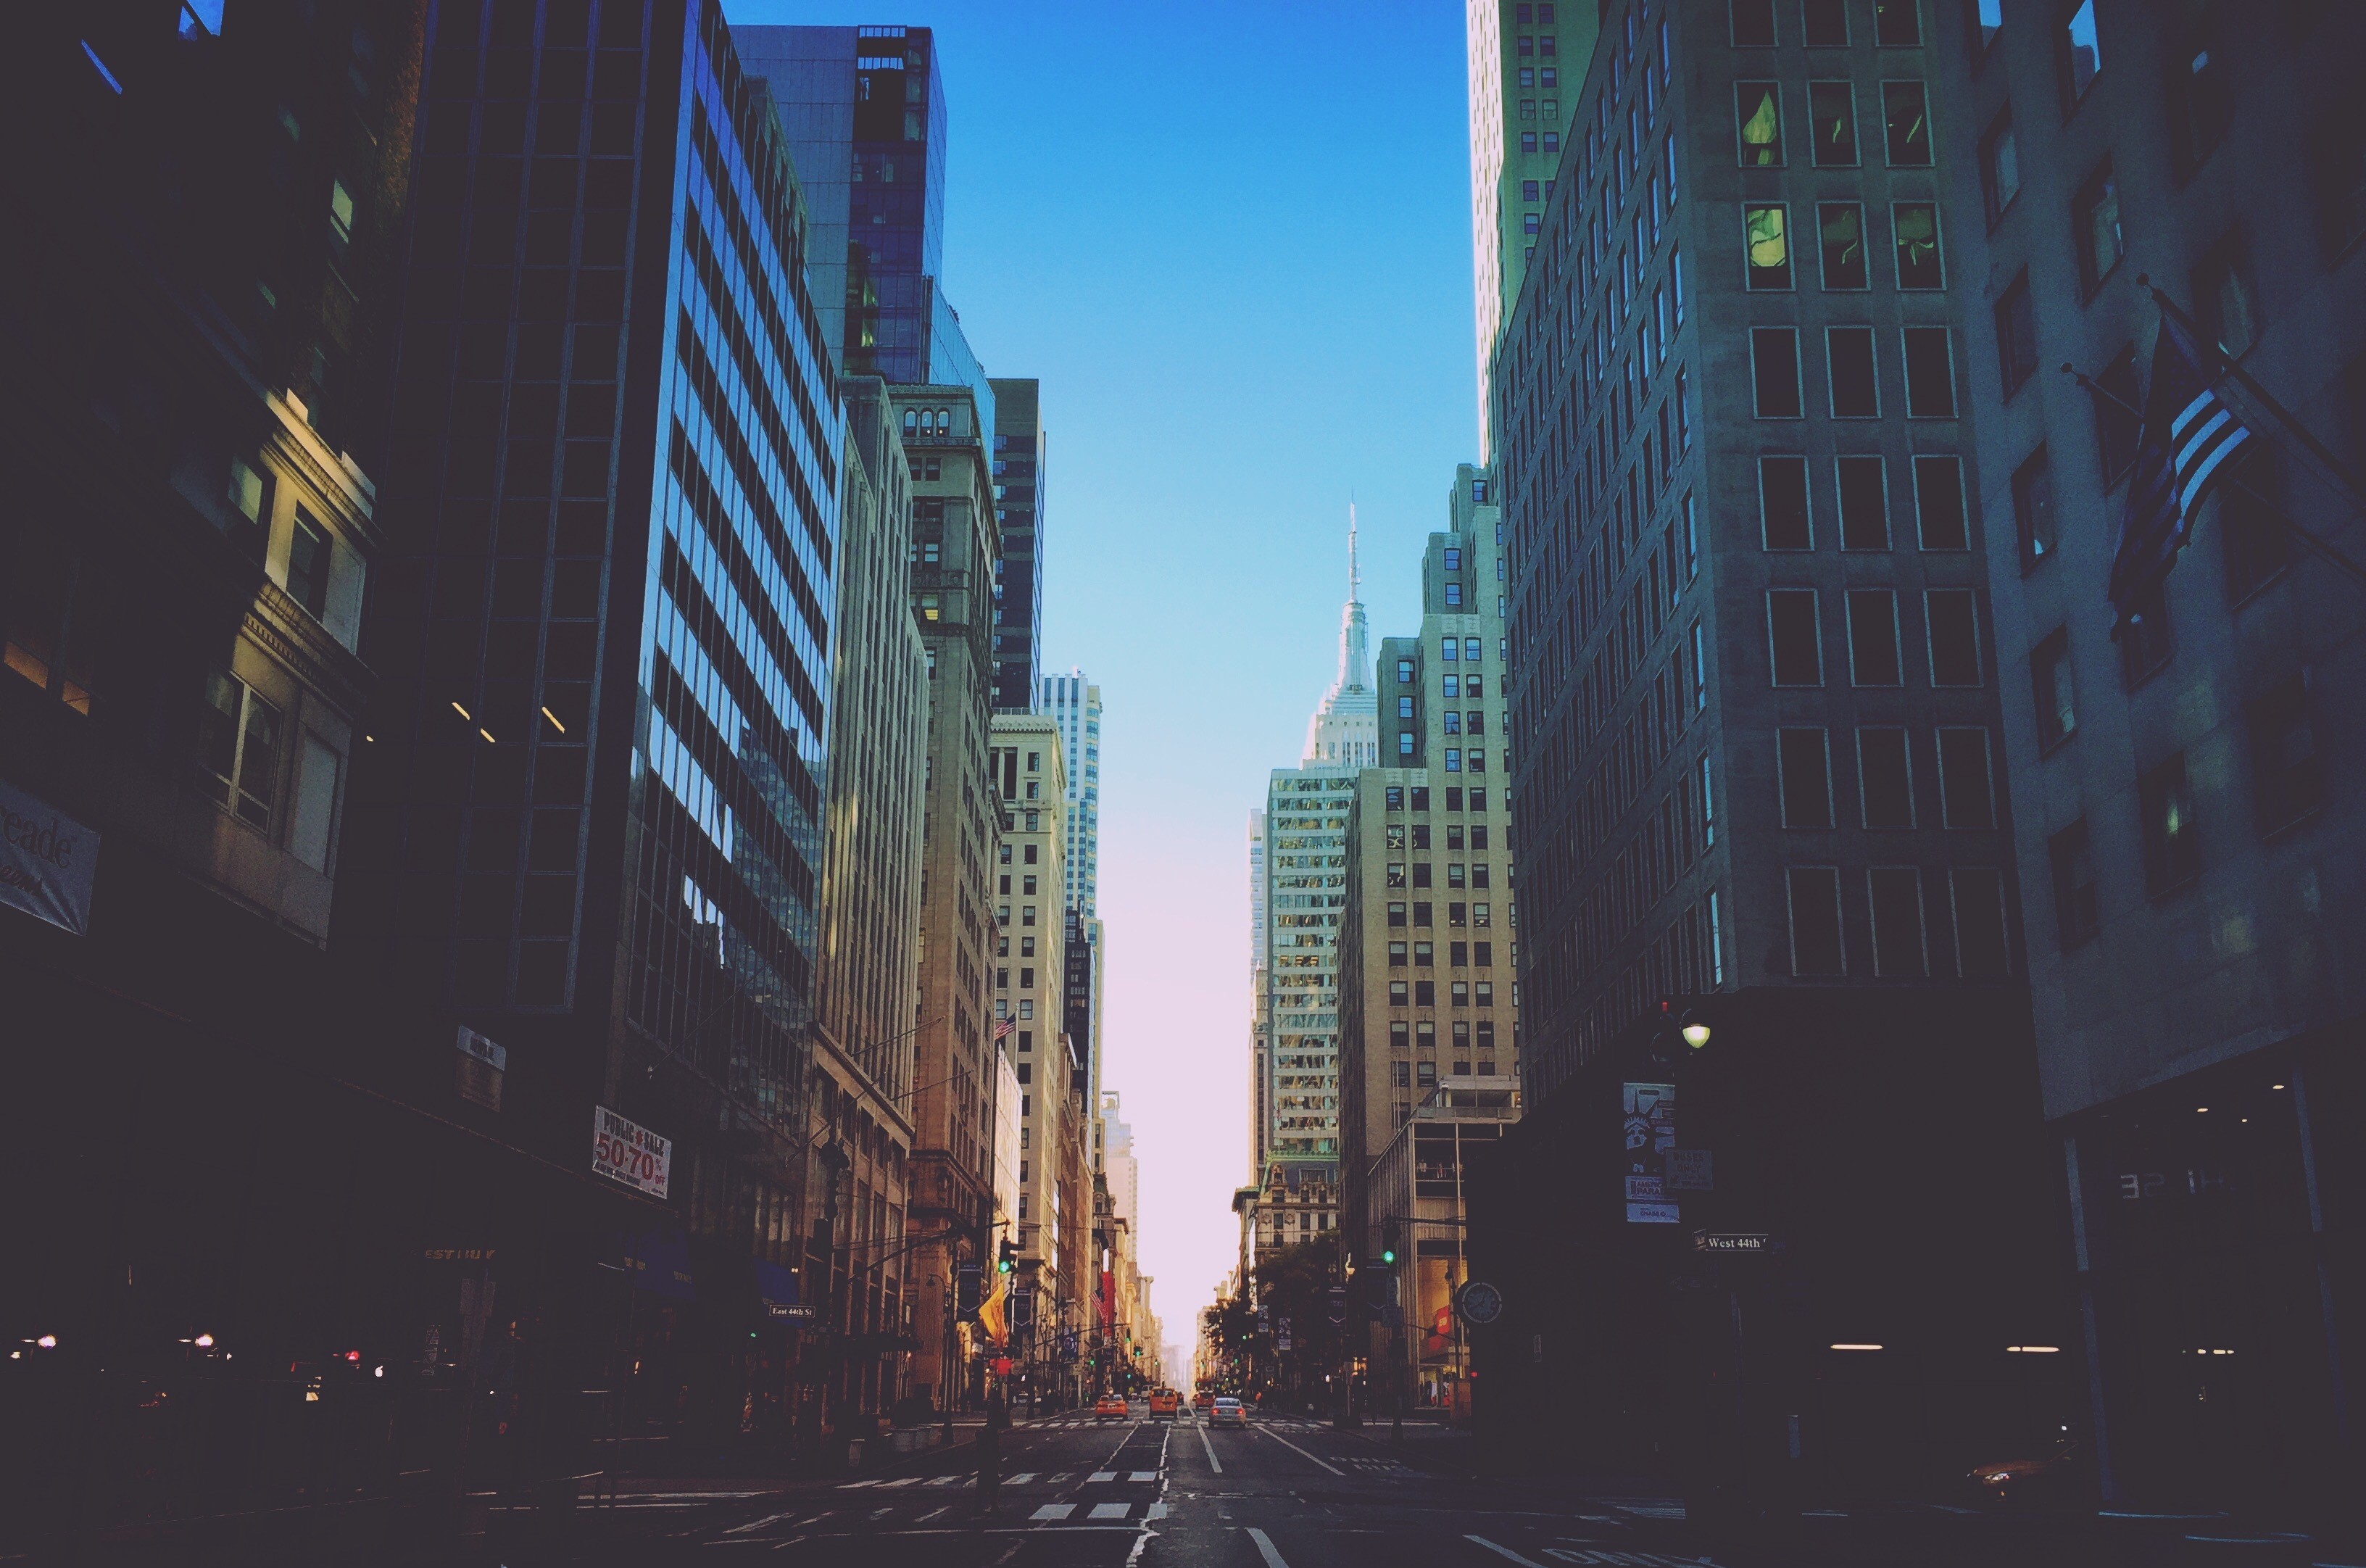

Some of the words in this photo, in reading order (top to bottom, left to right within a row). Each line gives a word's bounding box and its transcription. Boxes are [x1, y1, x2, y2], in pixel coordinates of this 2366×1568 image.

[0, 805, 72, 868] eade
[604, 1111, 635, 1143] PUBLIC
[644, 1132, 665, 1157] SALE
[425, 1248, 455, 1260] EST
[1709, 1237, 1735, 1248] West
[1738, 1238, 1760, 1248] 44th
